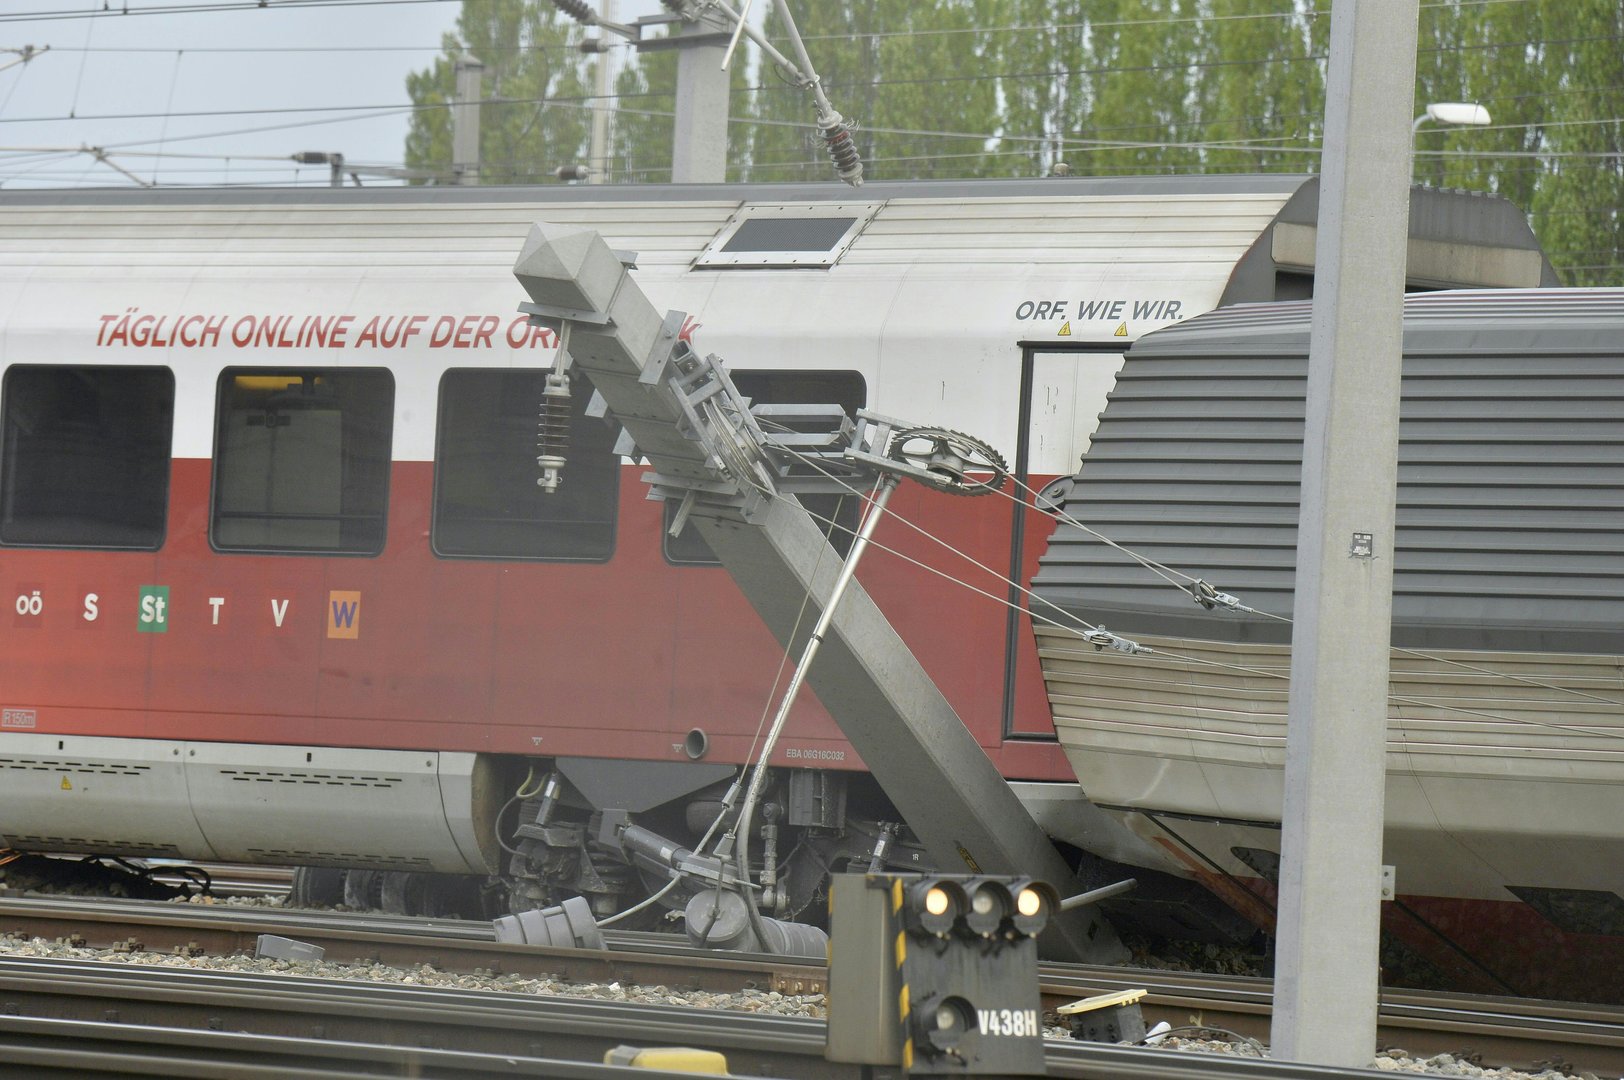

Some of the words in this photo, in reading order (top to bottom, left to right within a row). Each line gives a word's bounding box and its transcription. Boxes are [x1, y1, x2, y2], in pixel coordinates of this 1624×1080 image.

[1015, 300, 1068, 321] ORF.
[1077, 300, 1126, 320] WIE
[1132, 300, 1184, 320] WIR.
[96, 307, 229, 347] TÄGLICH
[231, 315, 356, 348] ONLINE
[354, 315, 430, 348] AUF
[429, 315, 501, 348] DER
[83, 593, 99, 621] S
[140, 595, 166, 624] St
[208, 597, 225, 625] T
[271, 599, 290, 627] V
[332, 600, 358, 628] W
[786, 748, 802, 759] EBA
[977, 1009, 1037, 1037] V438H
